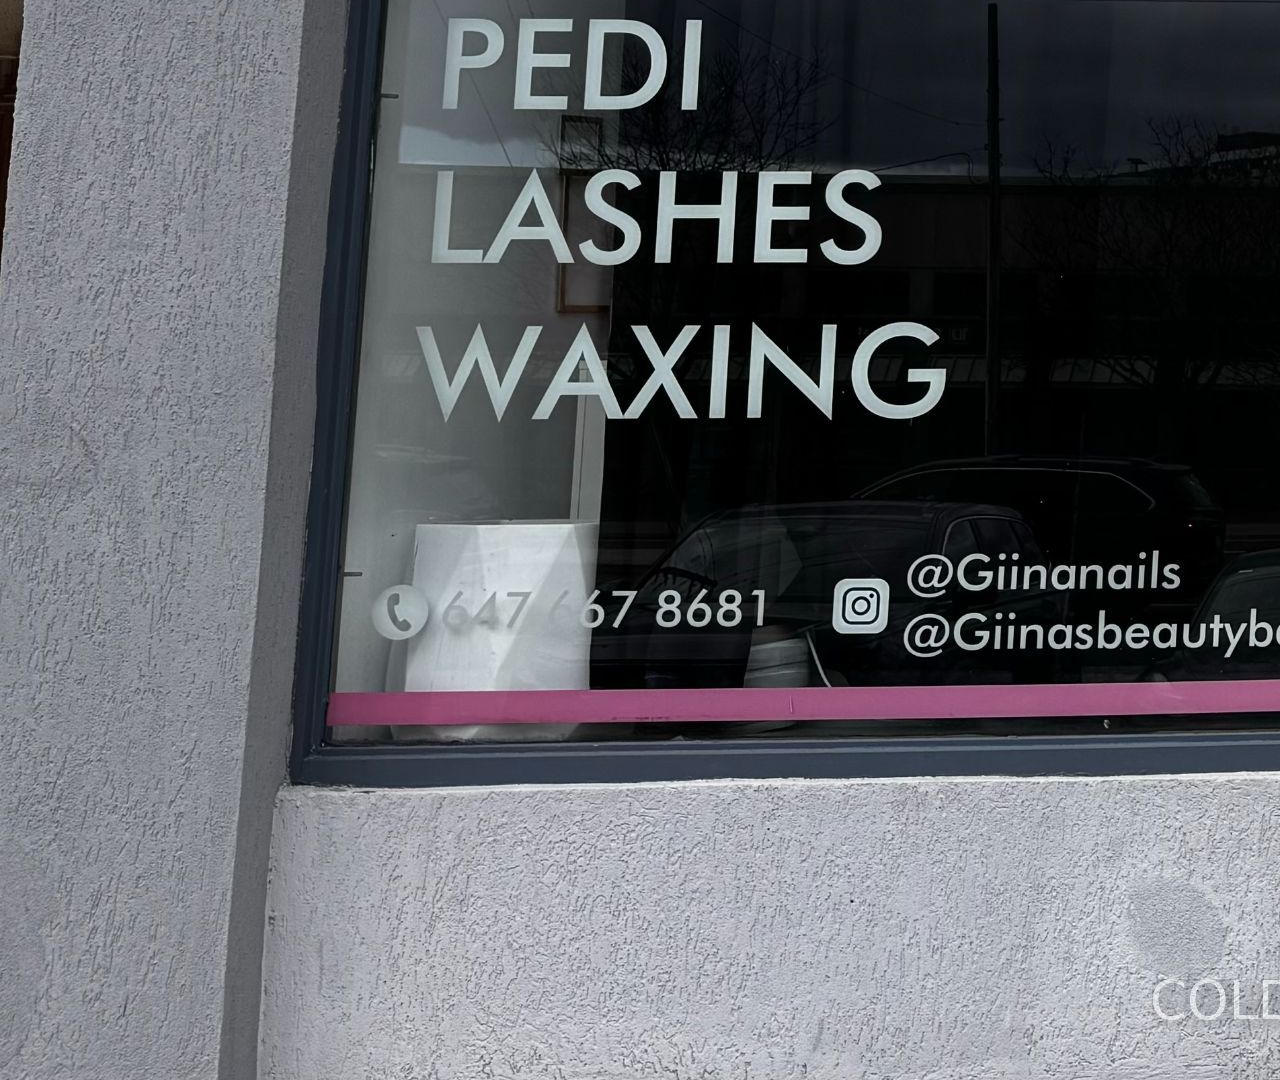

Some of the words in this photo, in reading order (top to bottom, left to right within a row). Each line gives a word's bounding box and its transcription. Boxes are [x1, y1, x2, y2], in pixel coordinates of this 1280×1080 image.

[441, 17, 702, 110] PEDI
[430, 168, 882, 265] LASHES
[415, 321, 948, 422] WAXING
[441, 588, 533, 630] 647
[654, 587, 767, 629] 8681
[906, 550, 1182, 599] @Giinanails
